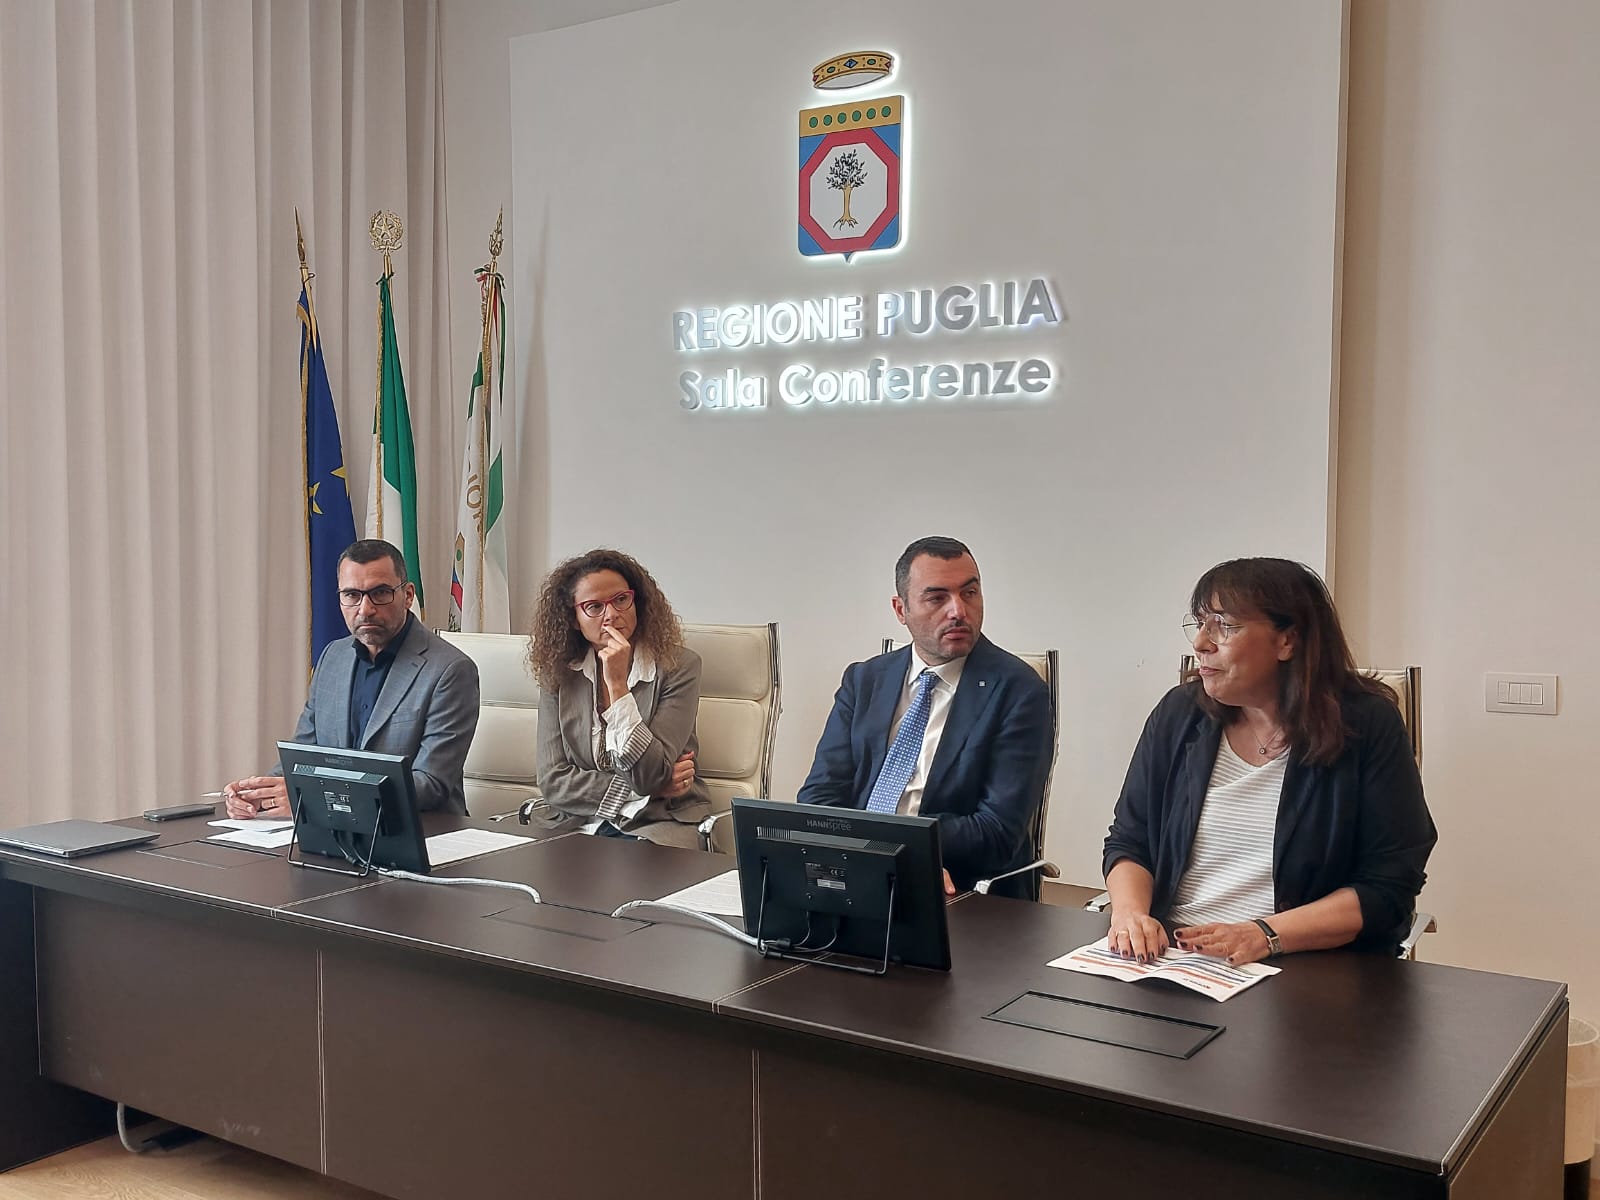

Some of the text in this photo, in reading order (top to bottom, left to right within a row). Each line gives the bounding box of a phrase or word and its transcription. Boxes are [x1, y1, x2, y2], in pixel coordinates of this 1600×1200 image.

[672, 279, 1060, 351] REGIONE PUGLIA
[679, 358, 1052, 410] Sala Conferenze
